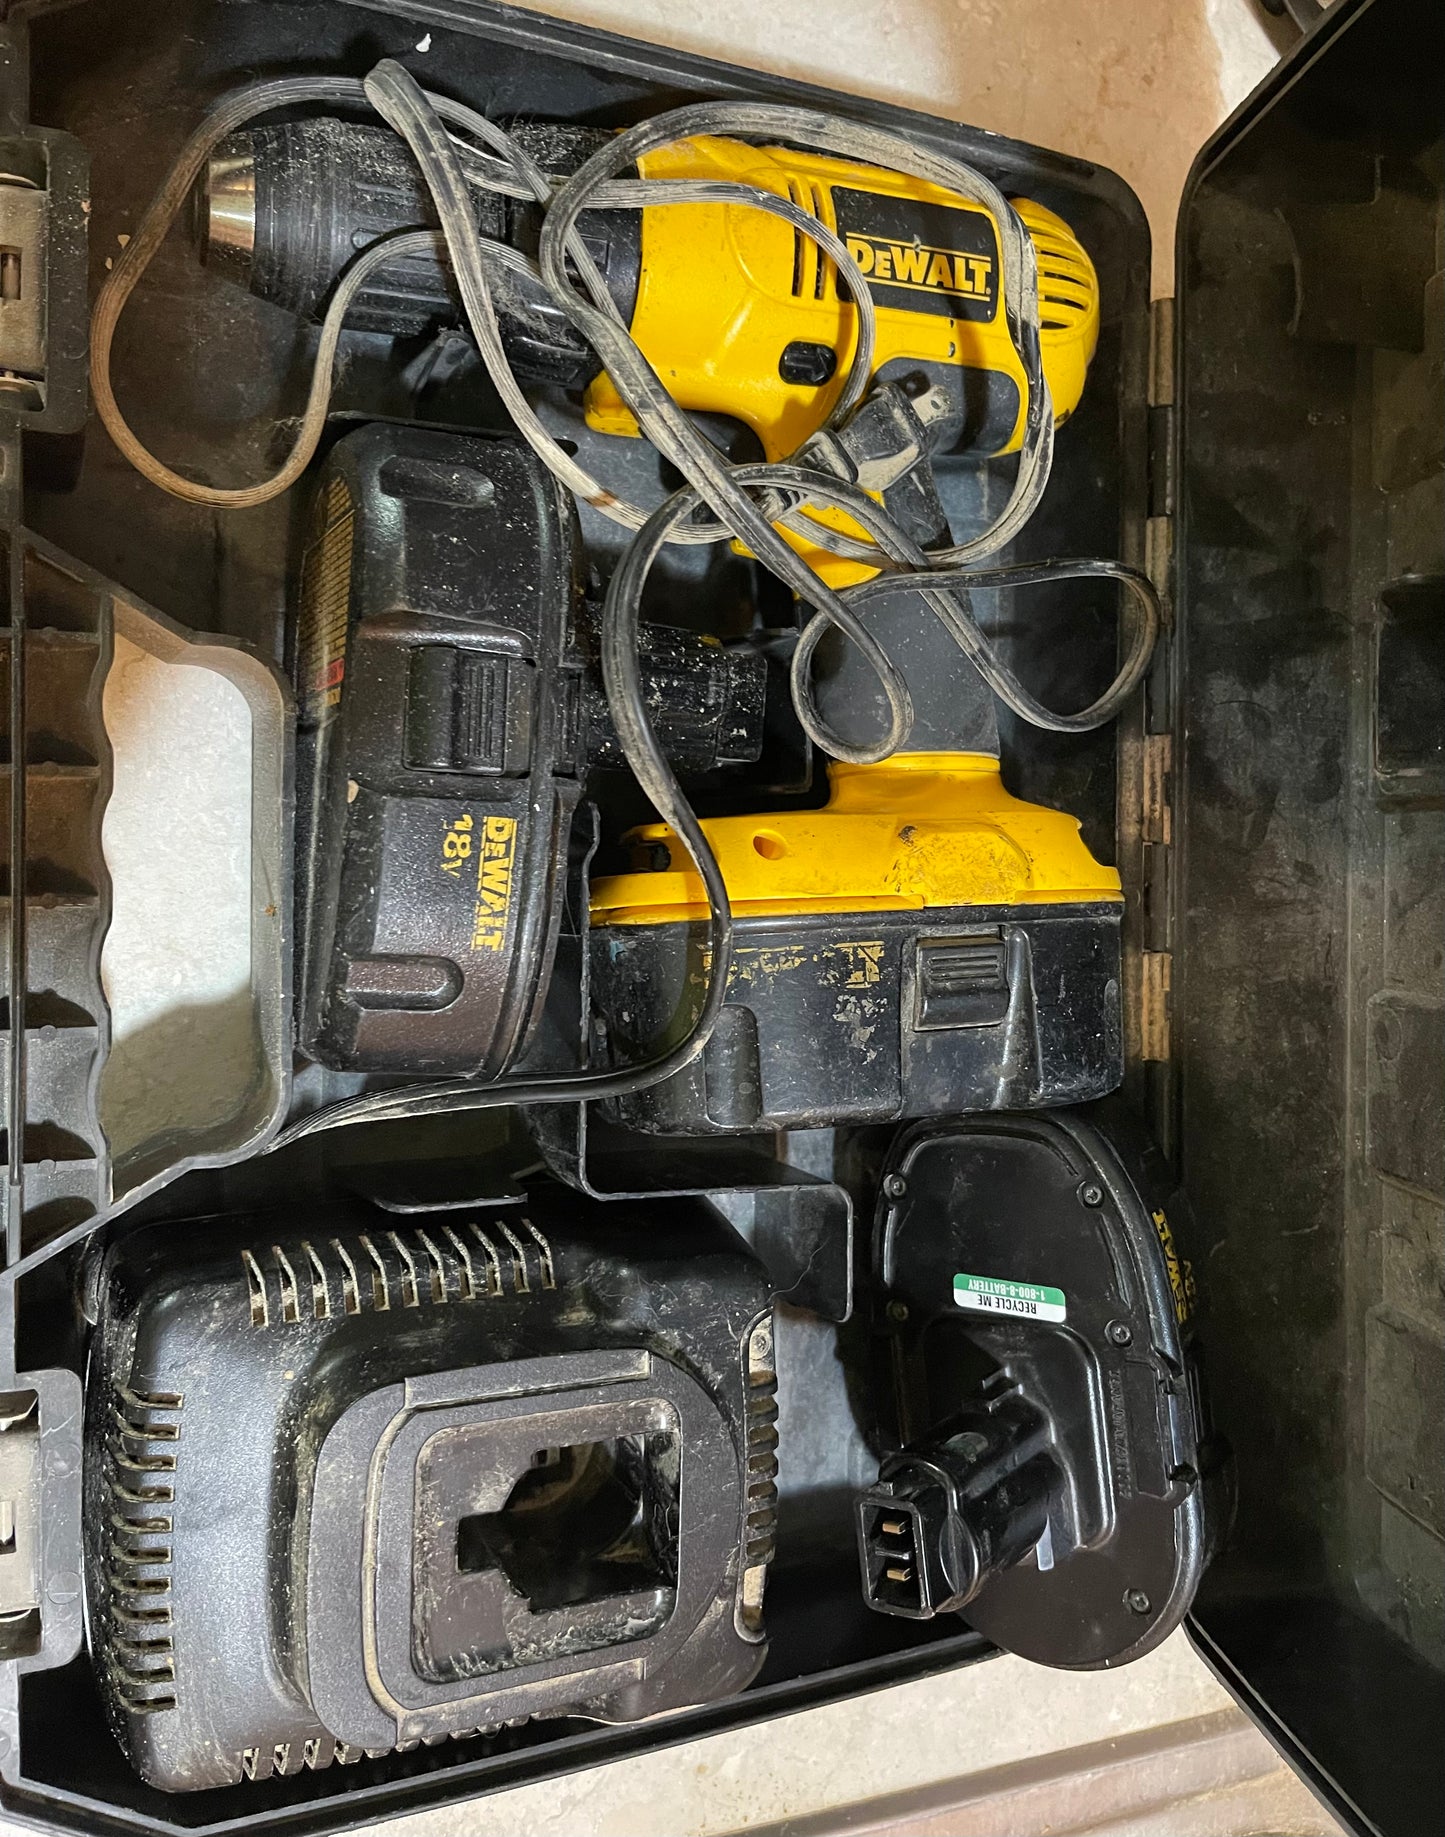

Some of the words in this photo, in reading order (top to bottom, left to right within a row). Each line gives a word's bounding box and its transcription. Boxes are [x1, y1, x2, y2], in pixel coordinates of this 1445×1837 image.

[846, 235, 992, 297] DEWALT
[967, 1279, 1046, 1301] 1-800-8-BATTERY
[977, 1293, 992, 1307] ME
[995, 1297, 1037, 1315] RECYCLE
